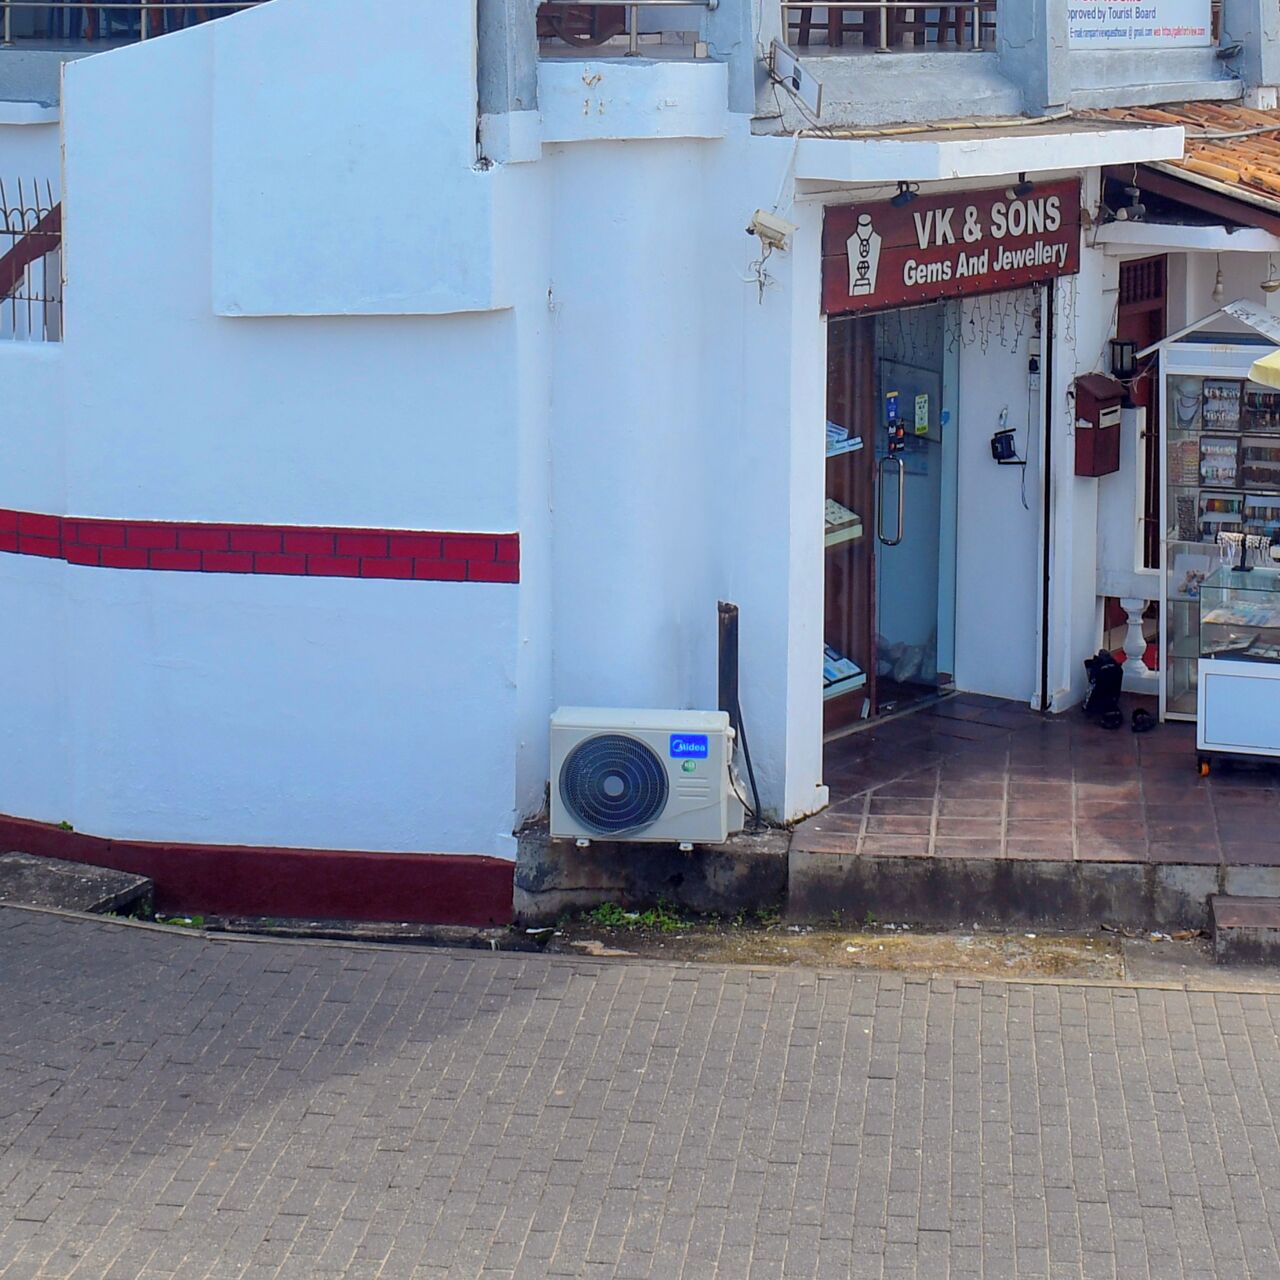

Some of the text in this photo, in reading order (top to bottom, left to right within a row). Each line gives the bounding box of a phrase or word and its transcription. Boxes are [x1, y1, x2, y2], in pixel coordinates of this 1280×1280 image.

[1098, 7, 1107, 23] by
[1108, 6, 1133, 20] Tourist
[1135, 7, 1156, 20] Board
[913, 195, 1061, 250] VK & SONS
[903, 240, 1069, 286] Gems And Jewellery
[672, 739, 706, 752] Midea
